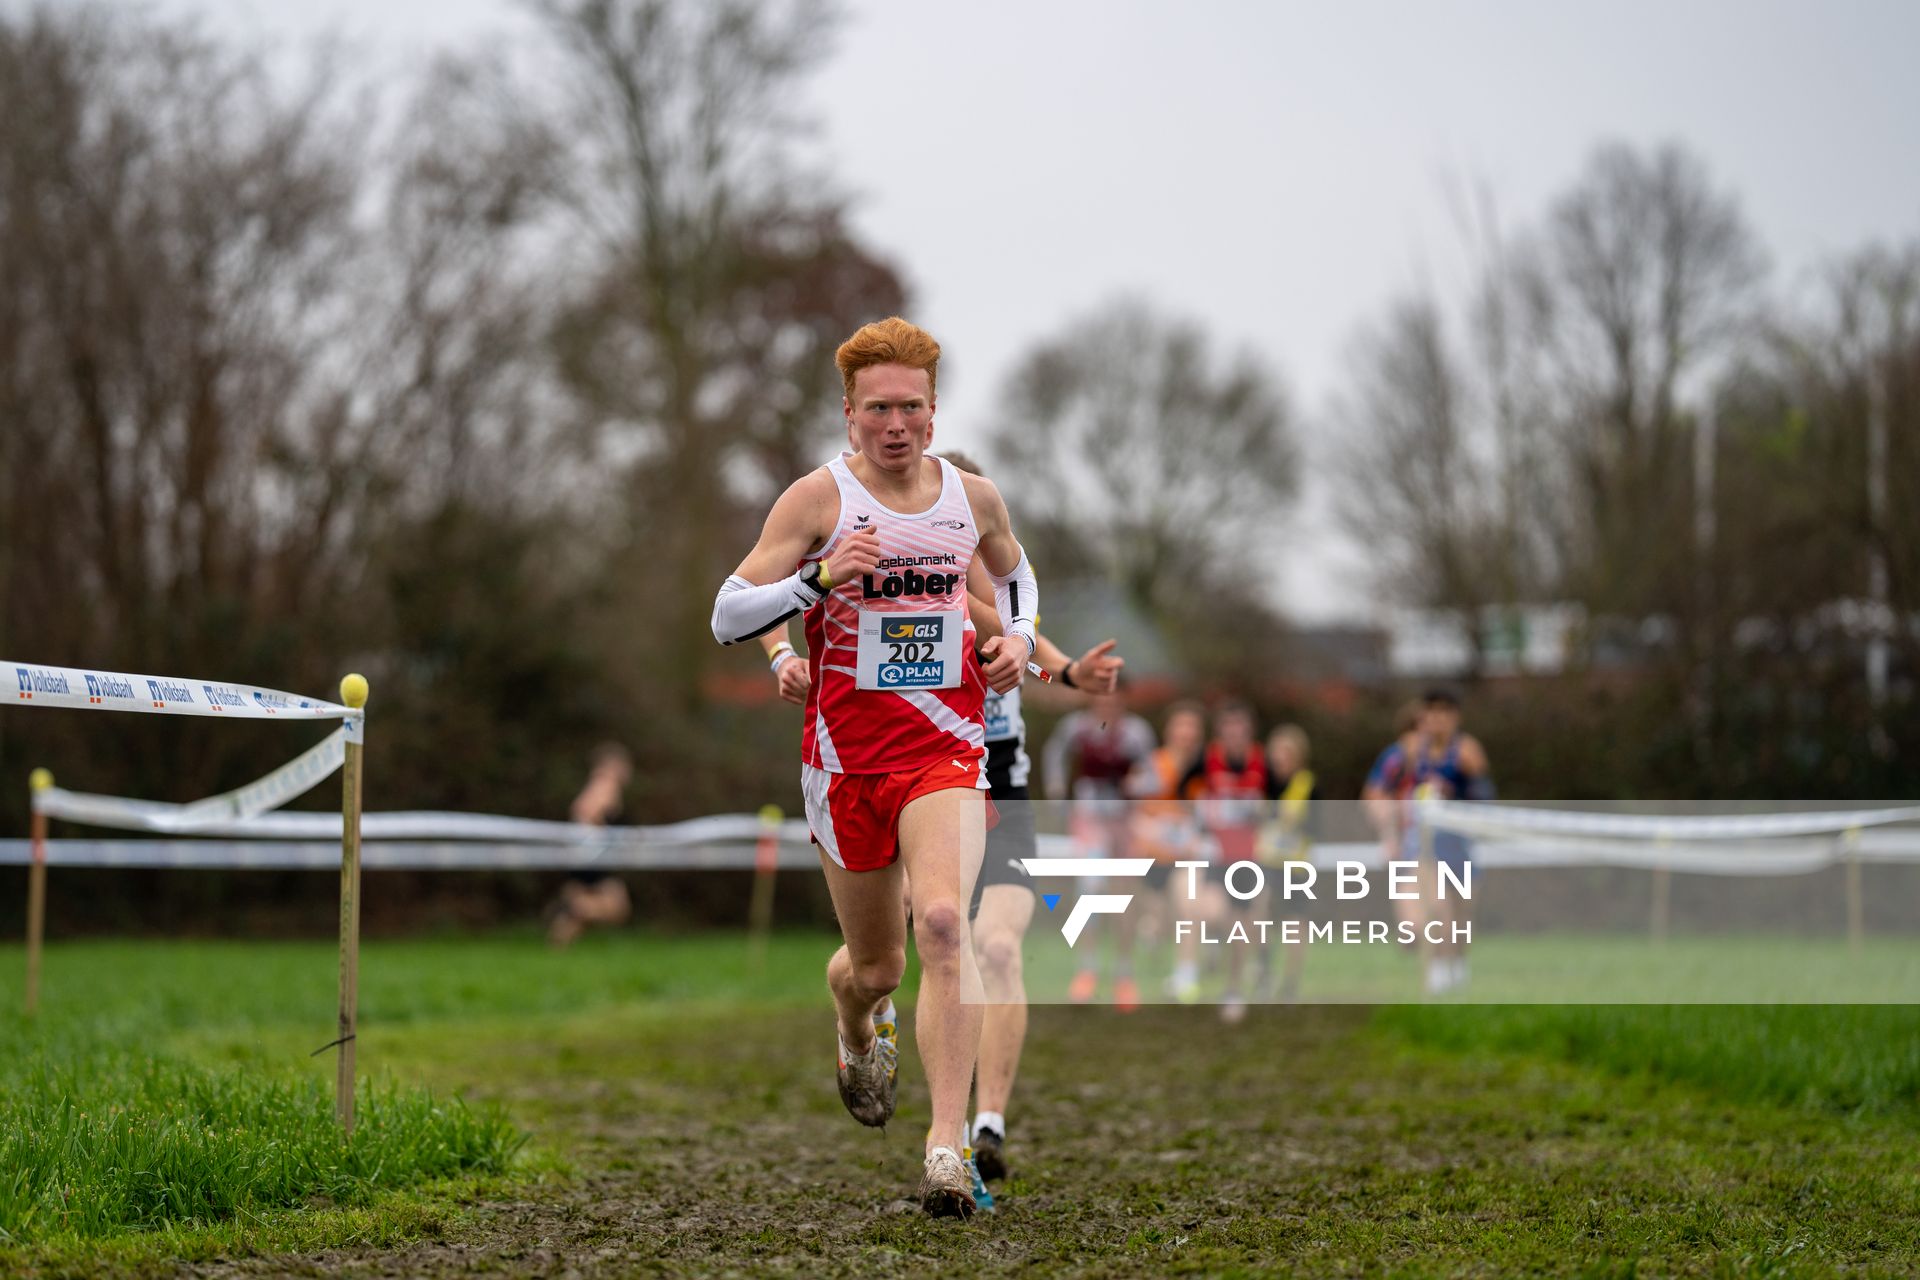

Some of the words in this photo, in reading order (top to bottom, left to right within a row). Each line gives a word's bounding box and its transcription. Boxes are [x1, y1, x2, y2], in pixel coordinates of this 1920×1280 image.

[863, 569, 959, 599] Löber
[914, 624, 938, 638] GLS
[888, 642, 935, 663] 202
[29, 669, 70, 695] Volksbank
[905, 666, 941, 678] PLAN
[98, 676, 135, 699] Volksbank
[159, 680, 195, 704] Volksbank
